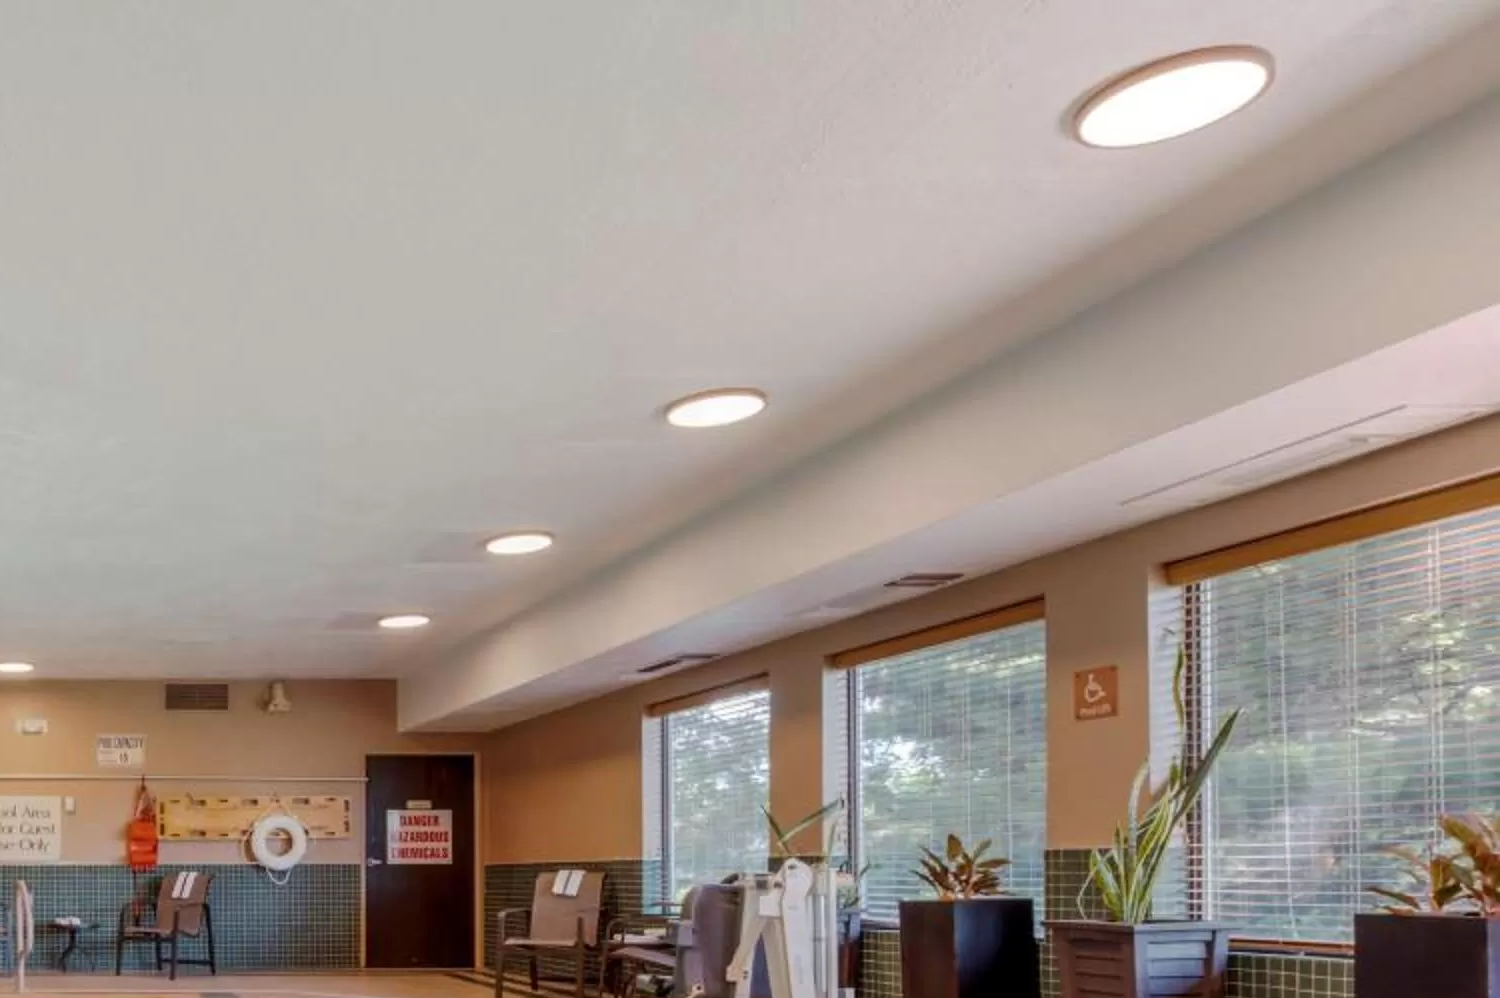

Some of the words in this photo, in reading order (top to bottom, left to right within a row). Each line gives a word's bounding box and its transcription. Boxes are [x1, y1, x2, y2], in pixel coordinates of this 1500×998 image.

[22, 805, 51, 818] Area
[400, 815, 439, 826] DANGER
[19, 823, 56, 834] Guest
[18, 838, 51, 853] Only
[391, 847, 449, 859] CHEMICALS
